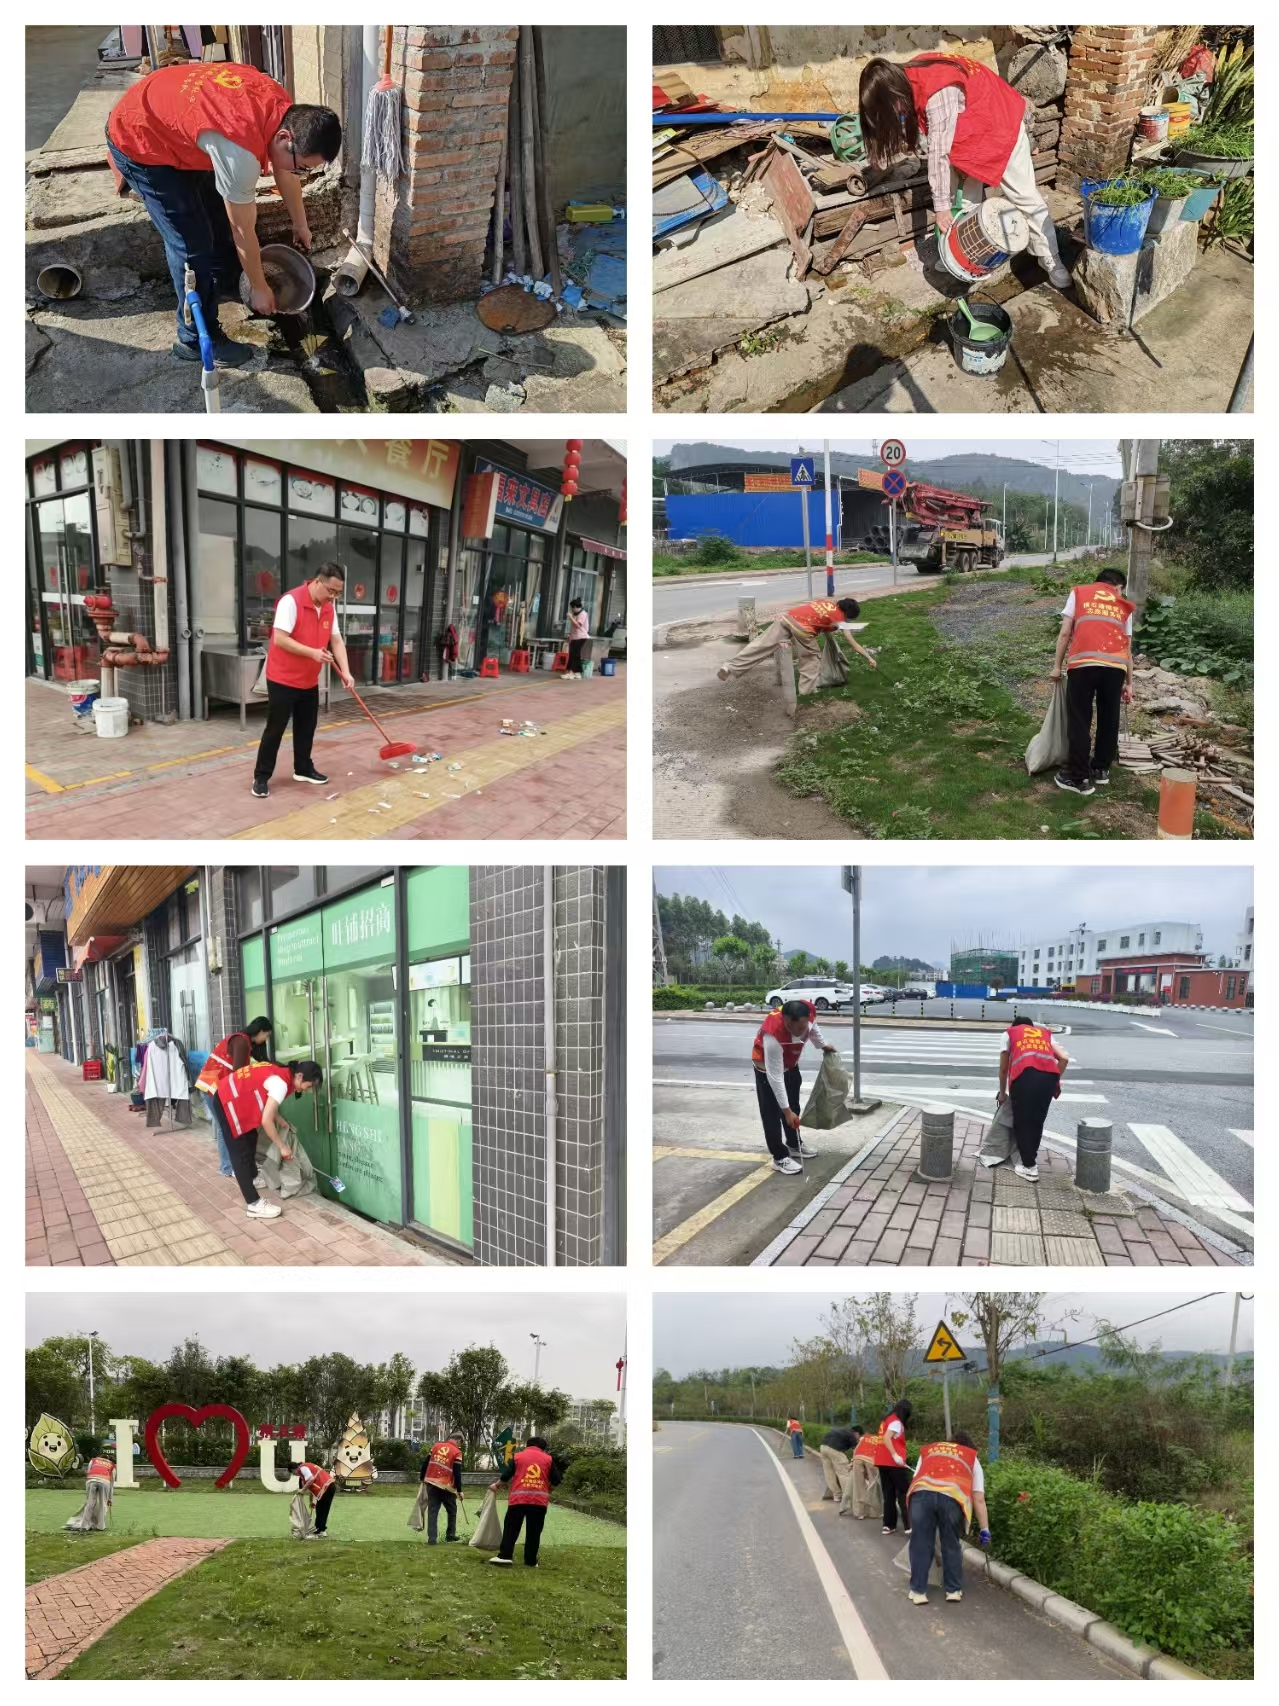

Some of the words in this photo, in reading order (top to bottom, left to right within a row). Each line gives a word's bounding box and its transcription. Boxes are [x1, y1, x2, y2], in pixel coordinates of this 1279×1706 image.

[886, 446, 901, 460] 20
[109, 1418, 140, 1488] I
[258, 1440, 308, 1493] U
